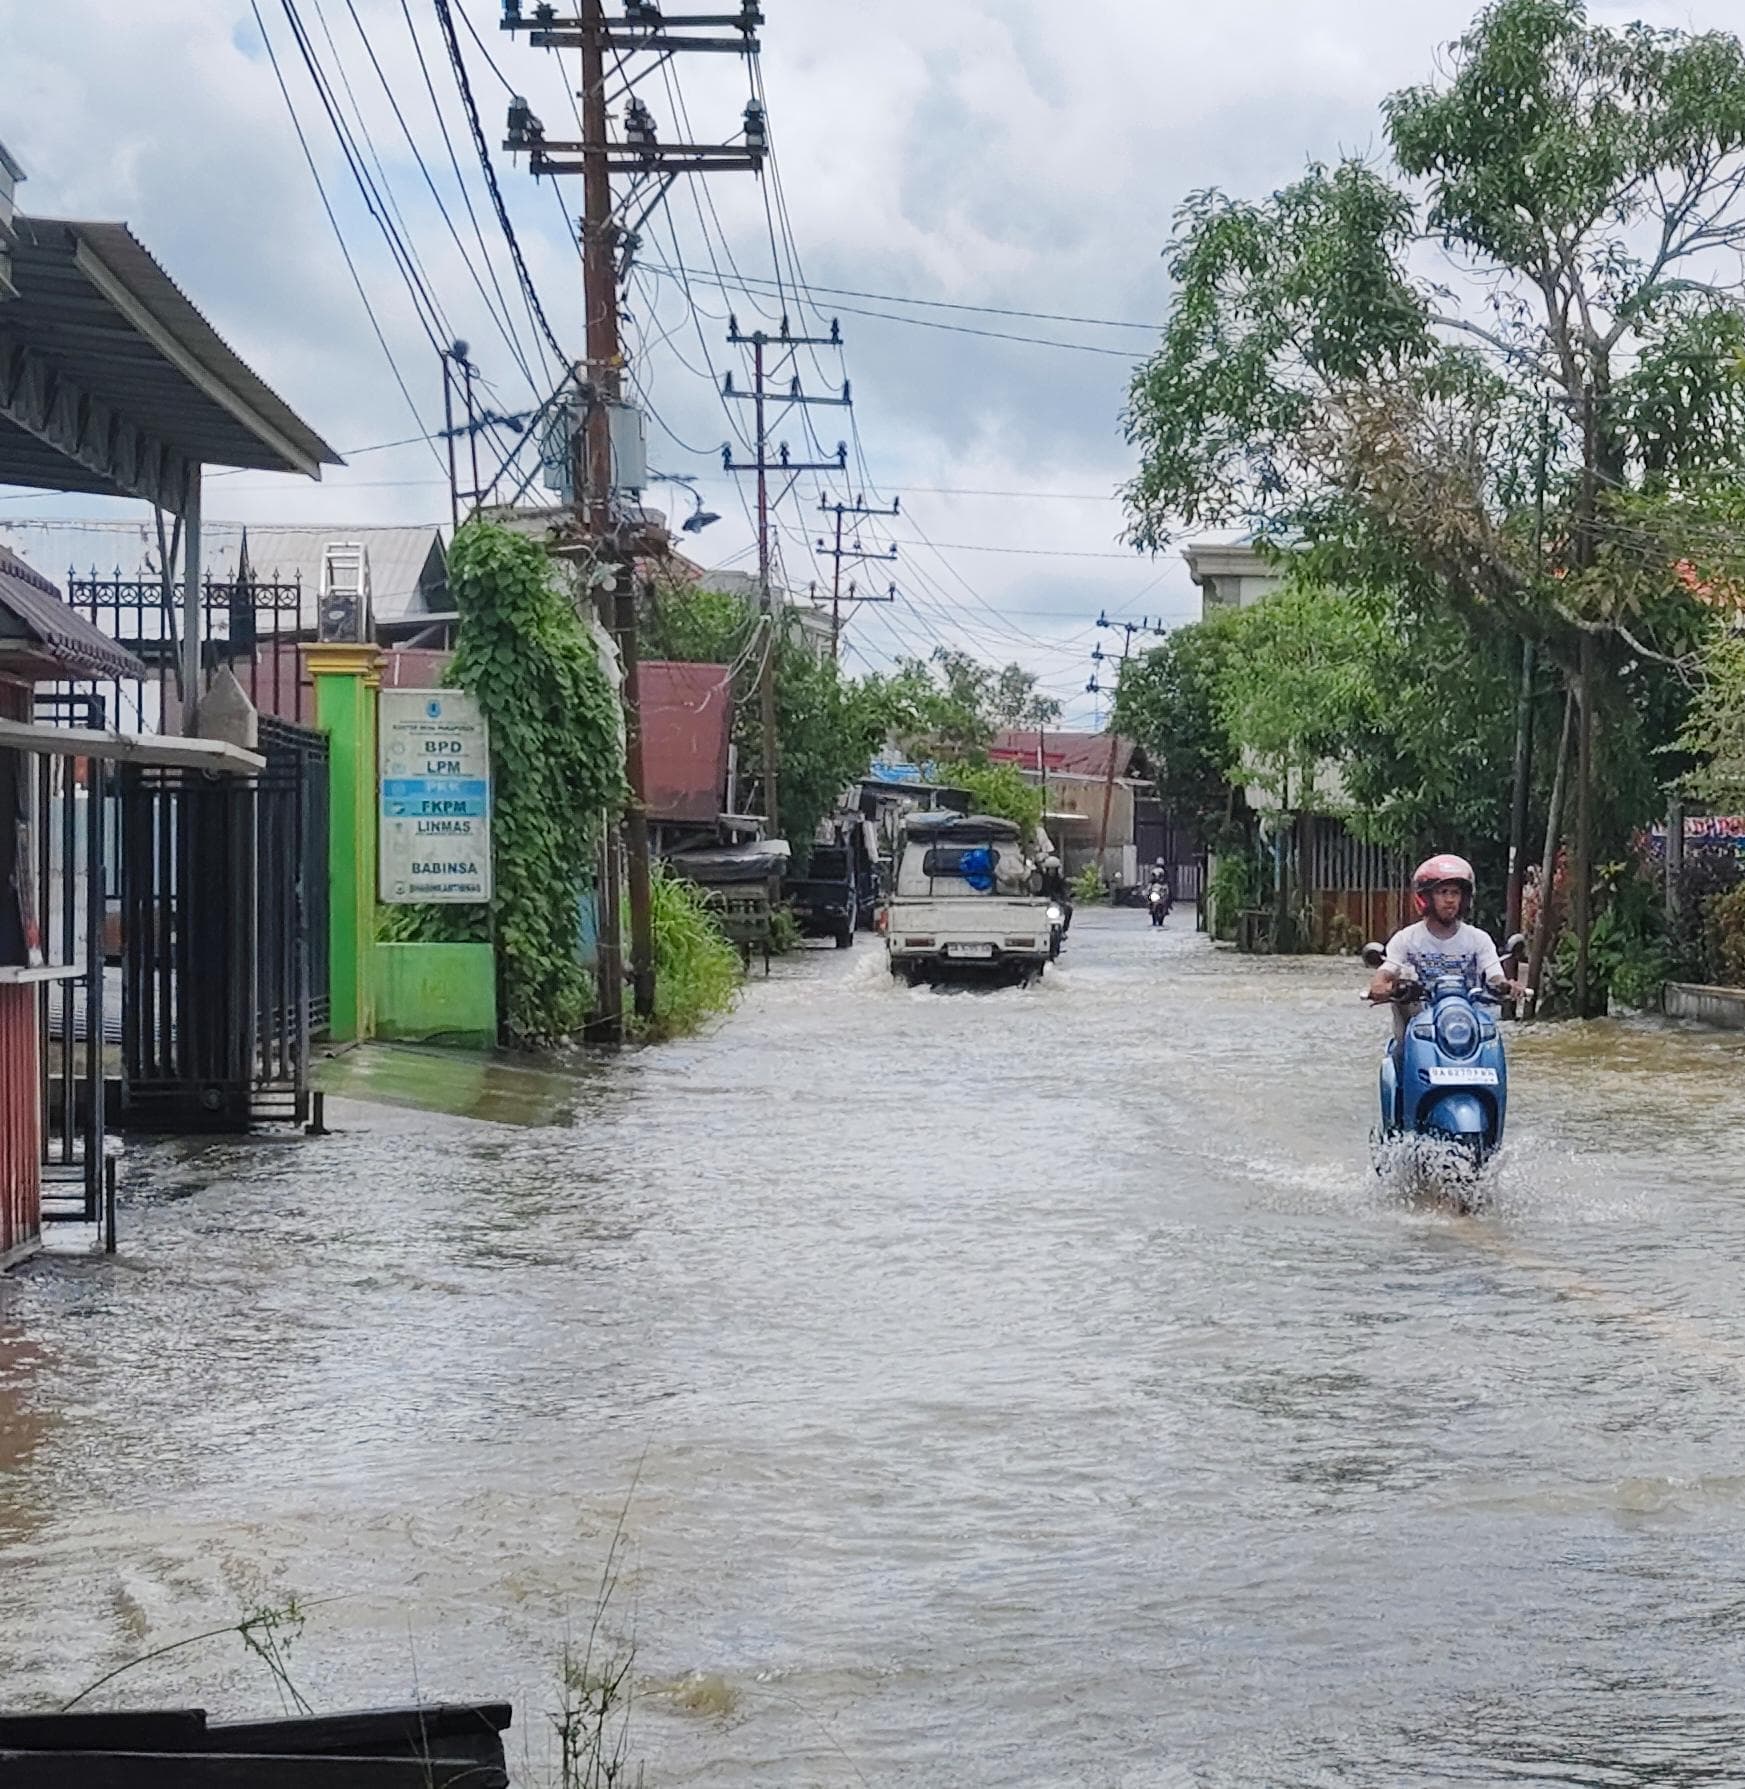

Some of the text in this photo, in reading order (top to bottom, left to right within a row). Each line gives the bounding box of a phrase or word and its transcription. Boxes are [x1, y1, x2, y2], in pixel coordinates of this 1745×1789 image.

[425, 741, 462, 753] BPD
[427, 761, 461, 774] LPM
[422, 801, 467, 813] FKPM
[418, 821, 471, 832] LINMAS
[412, 863, 478, 874] BABINSA
